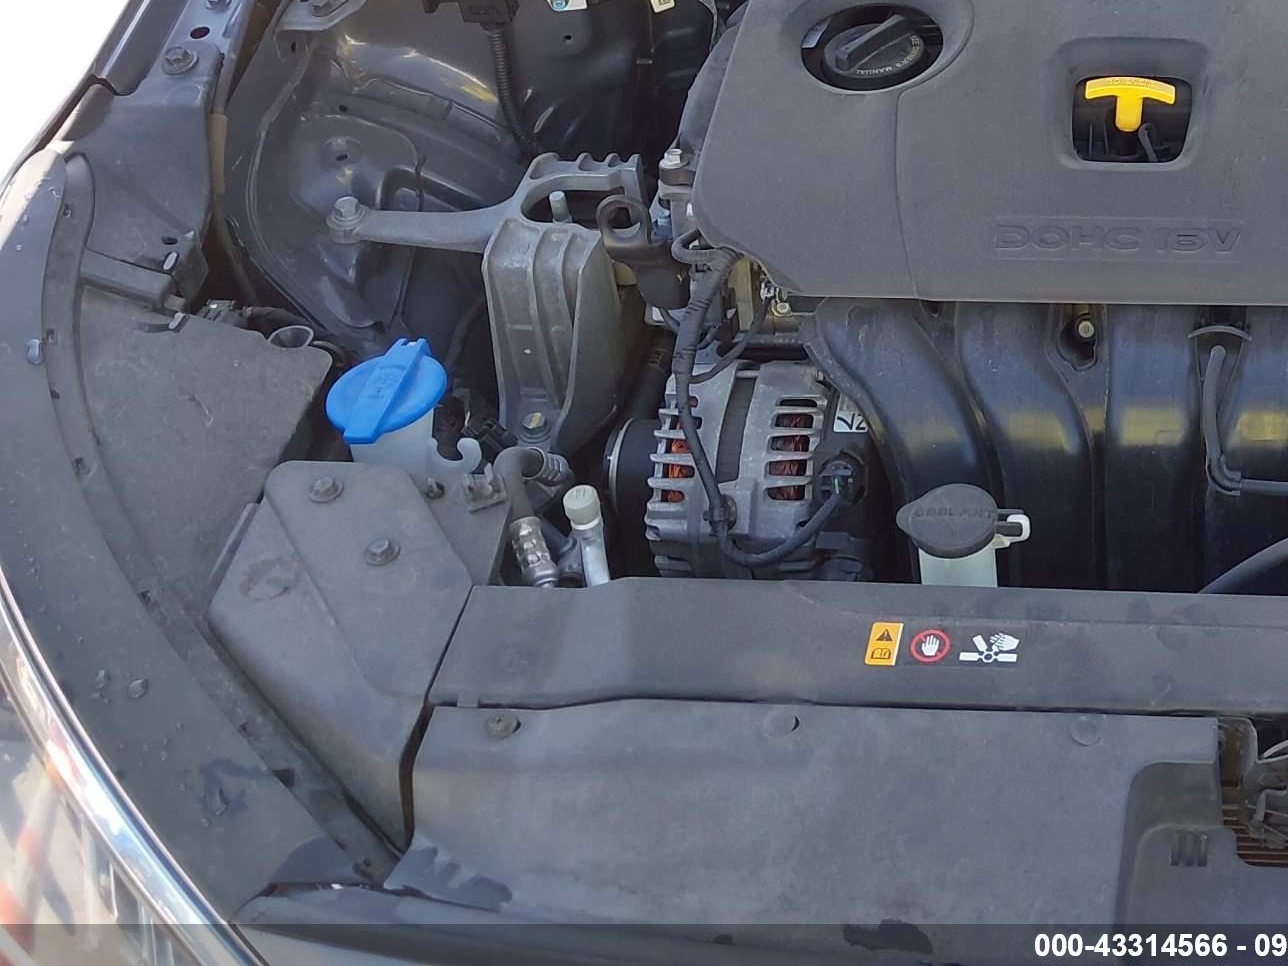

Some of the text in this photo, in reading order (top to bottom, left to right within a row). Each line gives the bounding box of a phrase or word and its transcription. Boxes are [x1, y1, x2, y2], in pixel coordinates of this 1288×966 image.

[856, 65, 893, 75] MANUAL
[992, 224, 1241, 253] DOHC 16V
[911, 507, 994, 519] COOLANT
